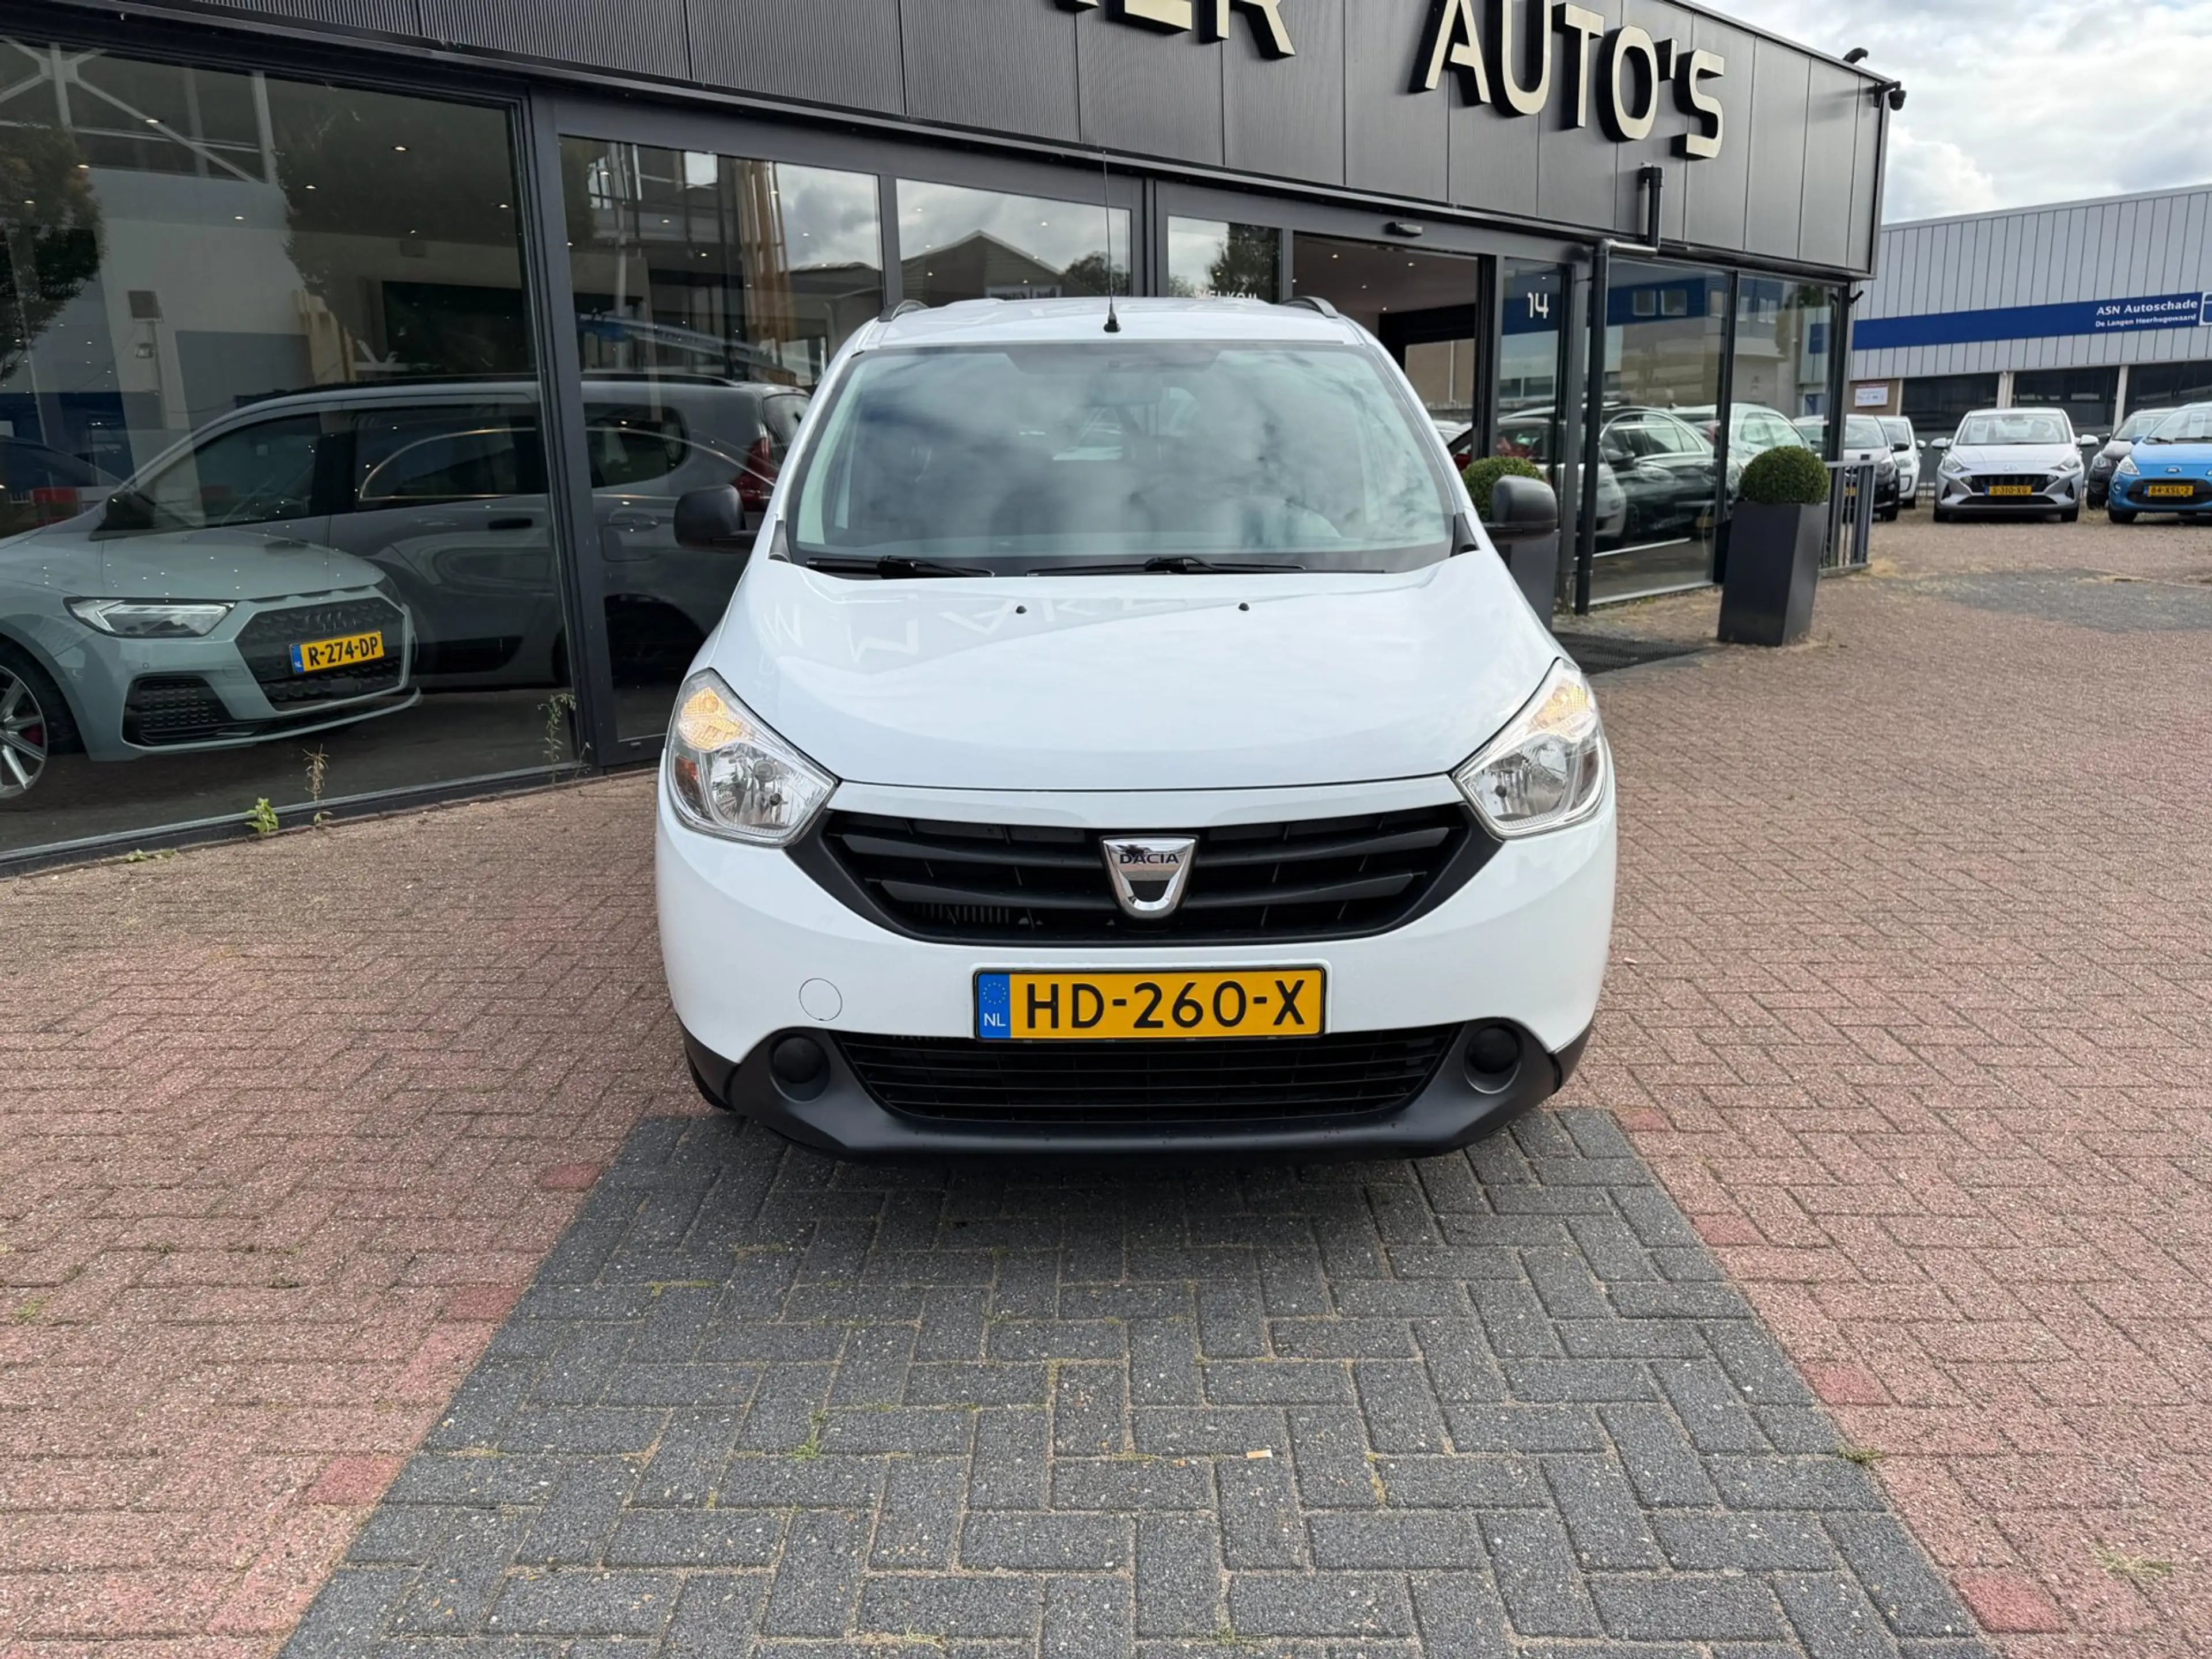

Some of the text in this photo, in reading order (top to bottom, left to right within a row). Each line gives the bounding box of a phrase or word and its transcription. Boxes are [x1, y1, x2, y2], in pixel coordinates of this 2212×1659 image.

[1423, 0, 1725, 159] AUTO'S
[1527, 292, 1549, 319] 14
[2096, 300, 2198, 316] ASN Autoschade
[307, 636, 378, 666] R-274-DP
[1120, 853, 1179, 864] DACIA
[1026, 980, 1305, 1029] HD-260-X
[984, 1013, 1006, 1027] NL
